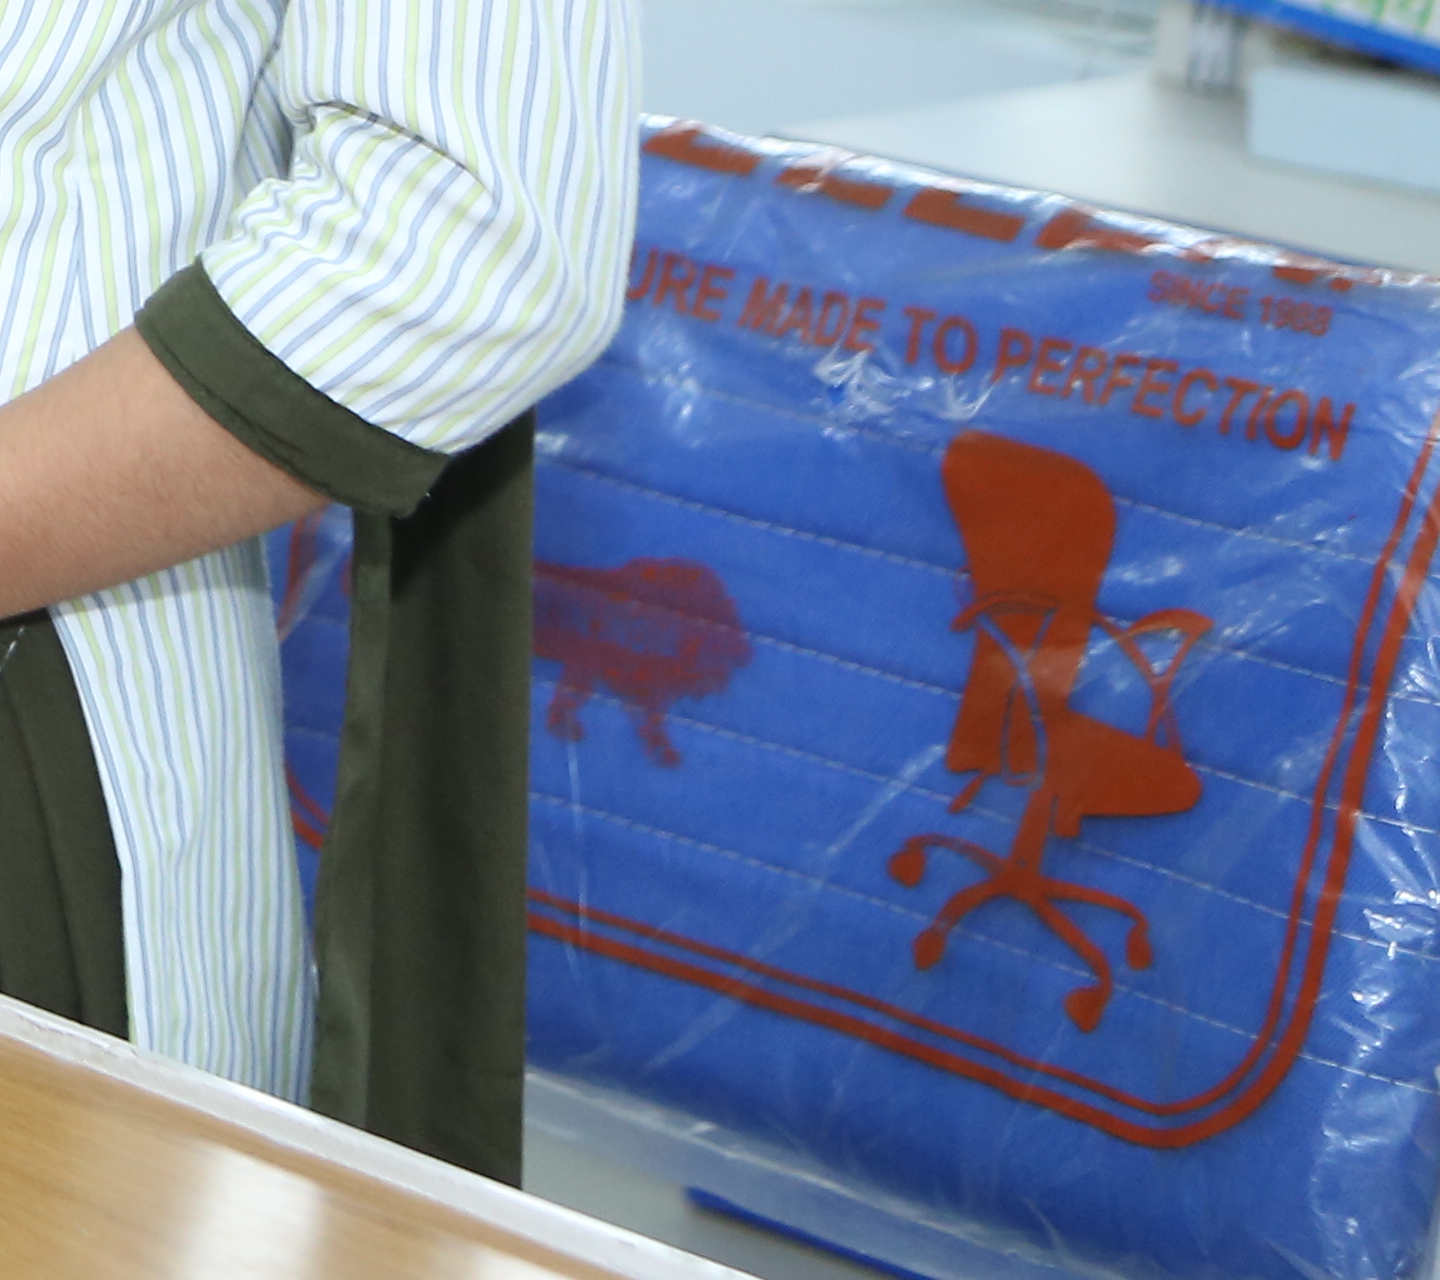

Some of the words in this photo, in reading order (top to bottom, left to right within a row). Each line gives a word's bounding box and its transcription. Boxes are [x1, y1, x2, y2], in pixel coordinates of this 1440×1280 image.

[1148, 269, 1251, 320] SINCE
[737, 274, 888, 354] MADE
[903, 304, 980, 375] TO
[992, 326, 1357, 462] PERFECTION
